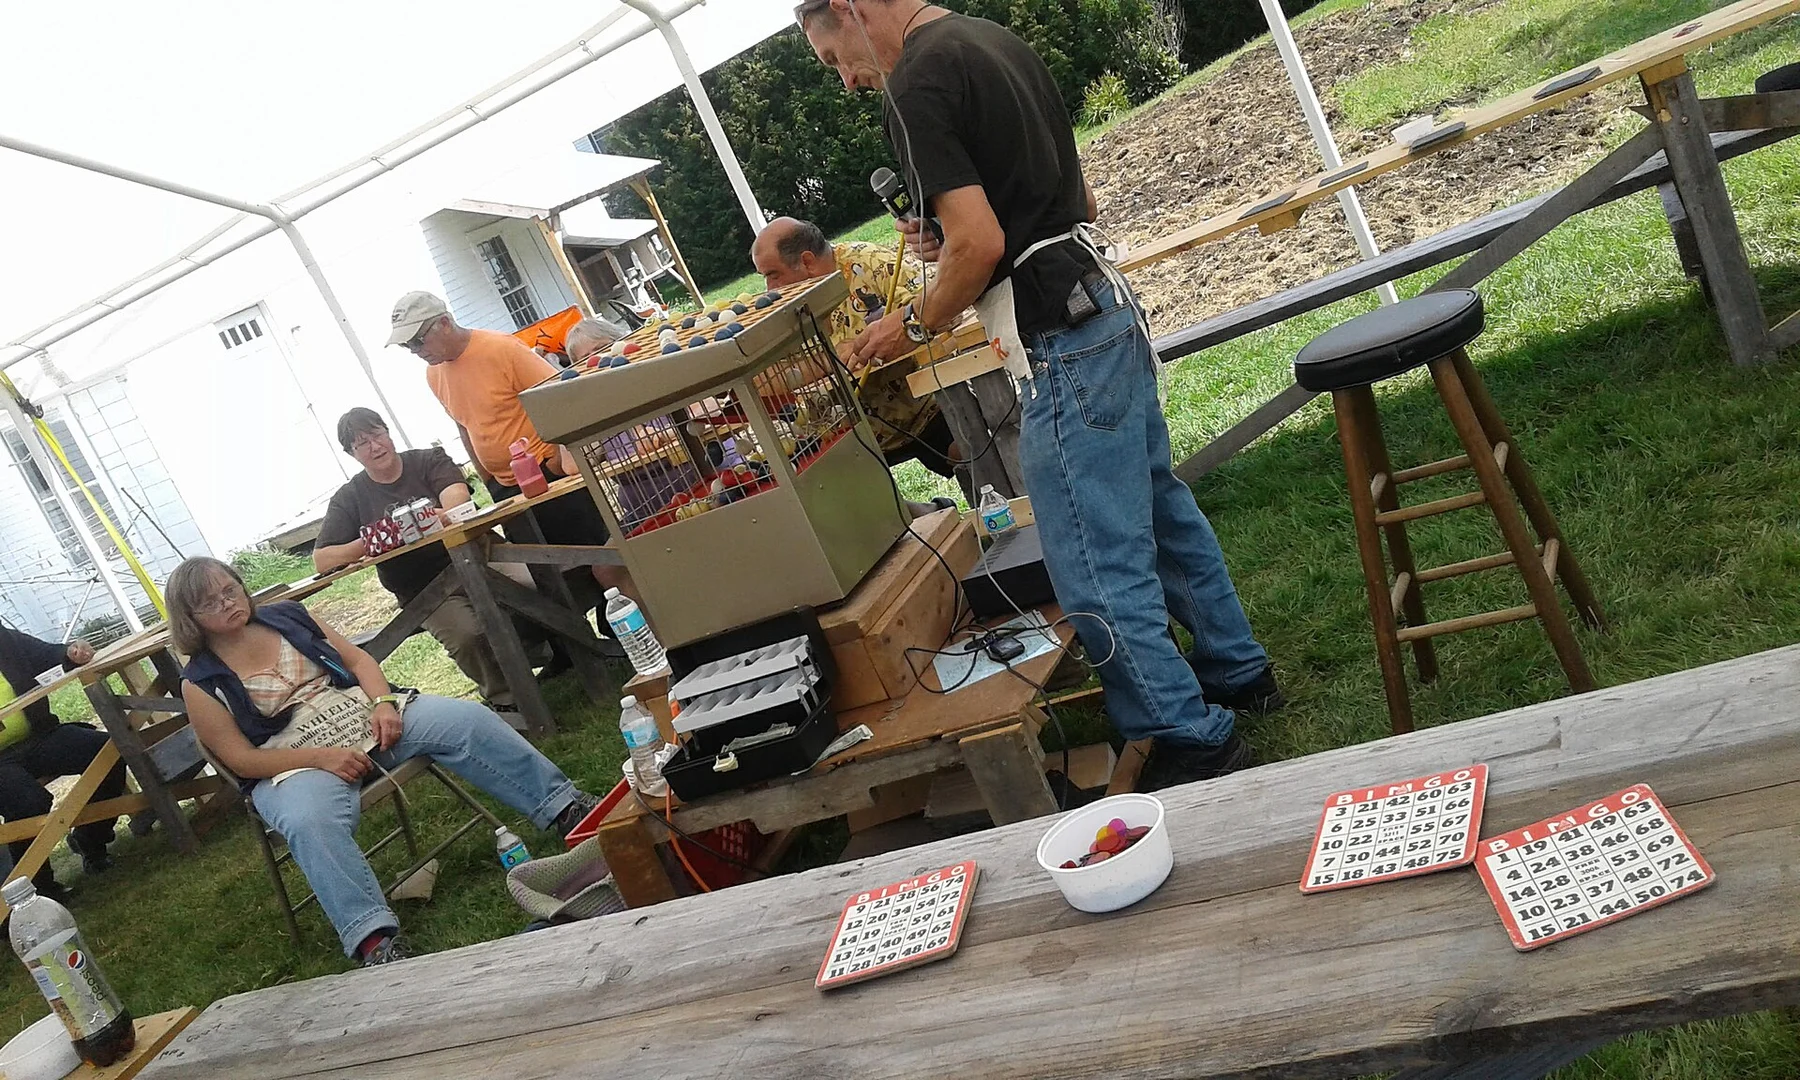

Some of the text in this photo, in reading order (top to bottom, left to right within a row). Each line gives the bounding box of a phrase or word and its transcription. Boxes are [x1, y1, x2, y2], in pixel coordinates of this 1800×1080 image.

[329, 718, 359, 736] Church
[1331, 798, 1470, 833] 6 25 33 51 66
[1335, 782, 1472, 816] 3 21 42 60 63
[1321, 814, 1468, 850] 10 22 55 67
[1324, 832, 1465, 867] 7 30 44 52 70
[1499, 802, 1652, 864] 1 19 41 49 63
[1507, 818, 1665, 881] 4 24 38 46 68
[1313, 850, 1462, 885] 15 18 43 48 75
[1508, 834, 1675, 901] 14 28 53 69
[1518, 853, 1690, 921] 10 23 37 48 72
[845, 920, 862, 930] 12
[867, 912, 888, 924] 20
[892, 905, 911, 918] 34
[916, 898, 936, 911] 54
[940, 890, 960, 903] 72
[856, 875, 964, 913] 9 21 38 56 74
[1528, 870, 1704, 940] 15 21 44 50 74
[834, 951, 851, 963] 13
[856, 944, 876, 956] 24
[881, 937, 902, 948] 40
[907, 928, 926, 941] 49
[931, 921, 951, 934] 62
[840, 935, 857, 947] 14
[862, 929, 881, 940] 19
[912, 913, 931, 926] 59
[937, 906, 955, 918] 61
[829, 936, 948, 978] 11 28 39 48 69
[79, 967, 107, 1001] pepsi
